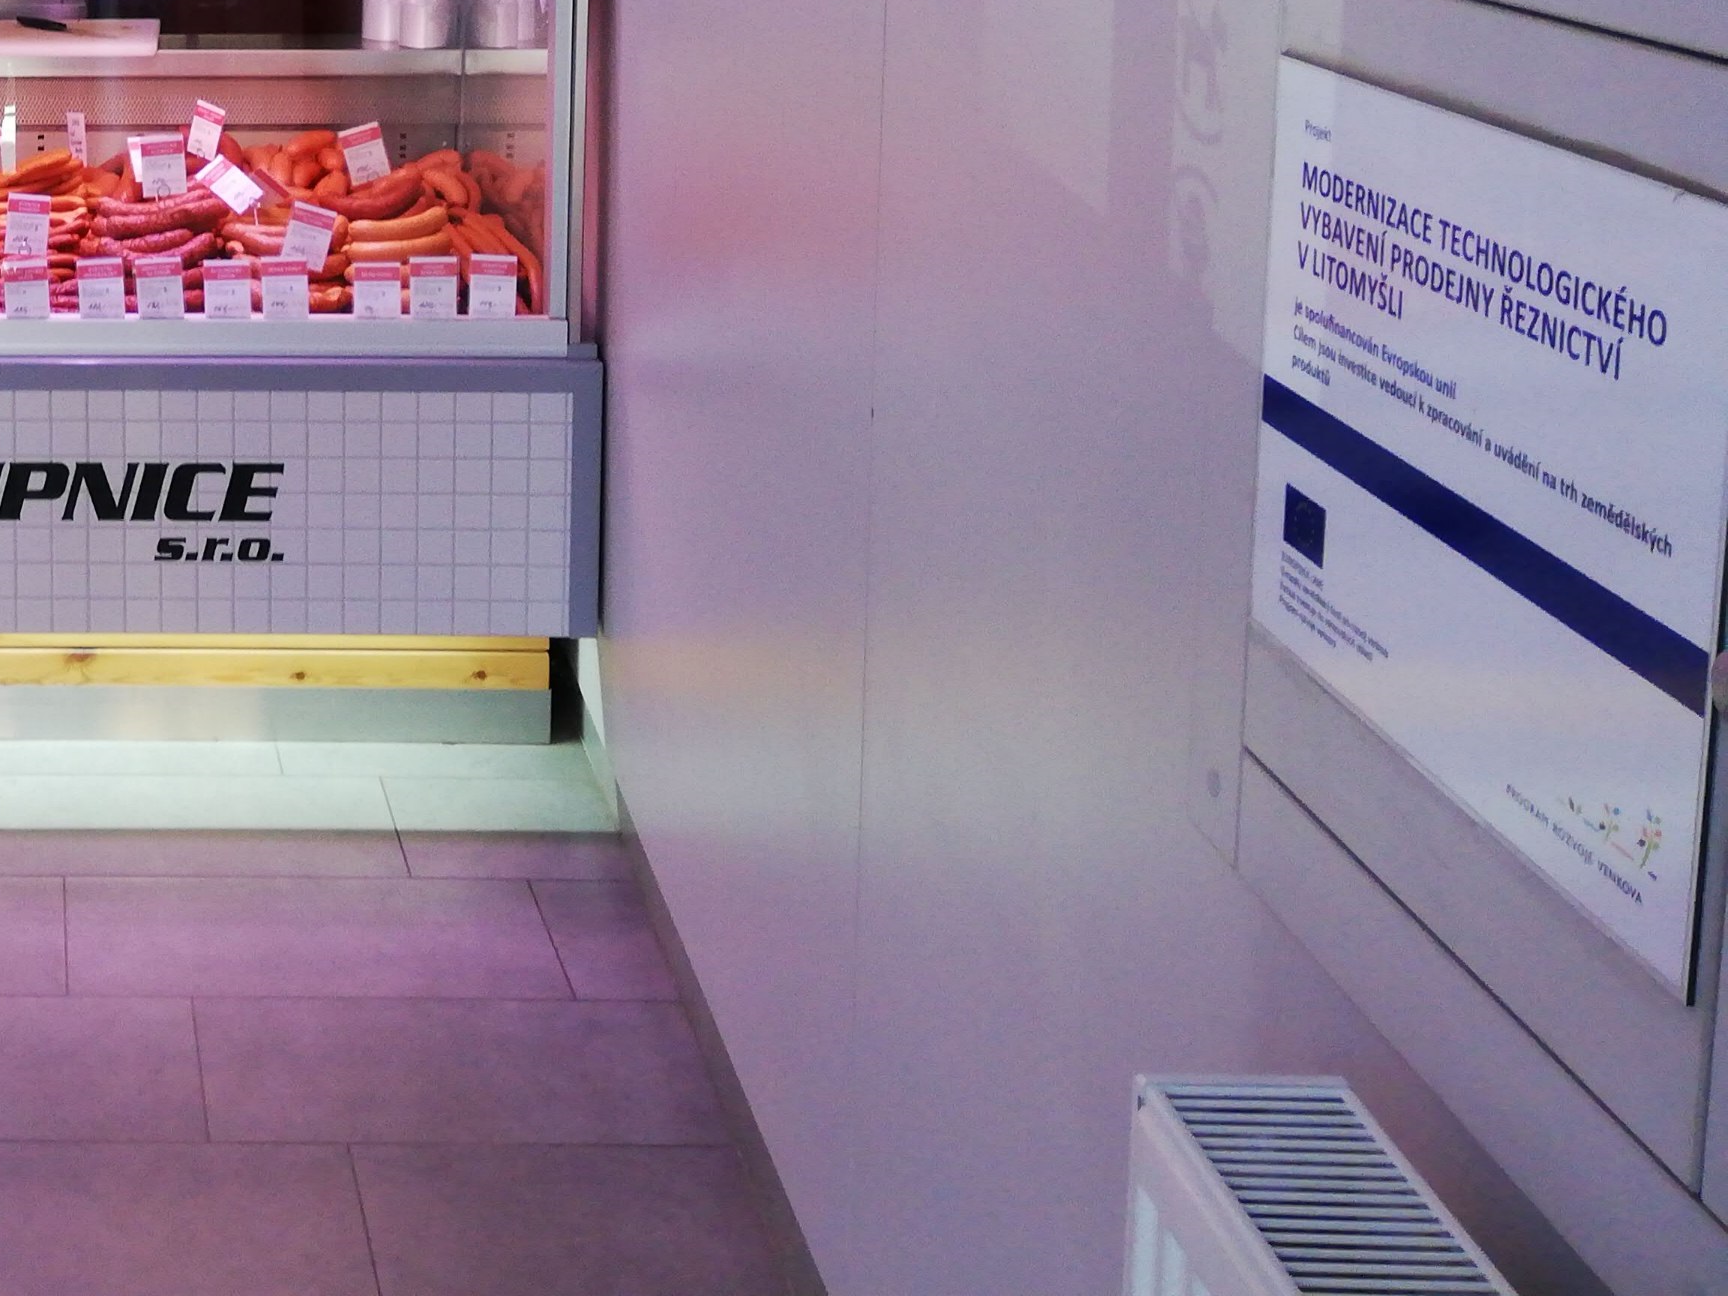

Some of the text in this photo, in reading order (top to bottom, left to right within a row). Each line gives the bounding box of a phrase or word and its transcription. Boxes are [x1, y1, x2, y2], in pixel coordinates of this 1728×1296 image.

[1297, 240, 1404, 320] V LITOMYŠLI
[1300, 201, 1625, 381] VYBAVENÍ PRODEJNY ŘEZNICTVÍ
[1302, 161, 1669, 348] MODERNIZACE TECHNOLOGICKÉHO
[1294, 296, 1304, 316] je
[1305, 306, 1379, 358] spolufinancován
[1381, 343, 1433, 387] Evropskou
[1379, 376, 1417, 409] vedoucí
[1418, 394, 1424, 414] k
[1426, 403, 1484, 447] zpracování
[1484, 437, 1491, 452] a
[1494, 442, 1542, 481] uvádění
[1542, 470, 1556, 490] na
[1560, 477, 1578, 504] trh
[1581, 492, 1672, 558] zemědělských
[154, 537, 284, 561] s.r.o.
